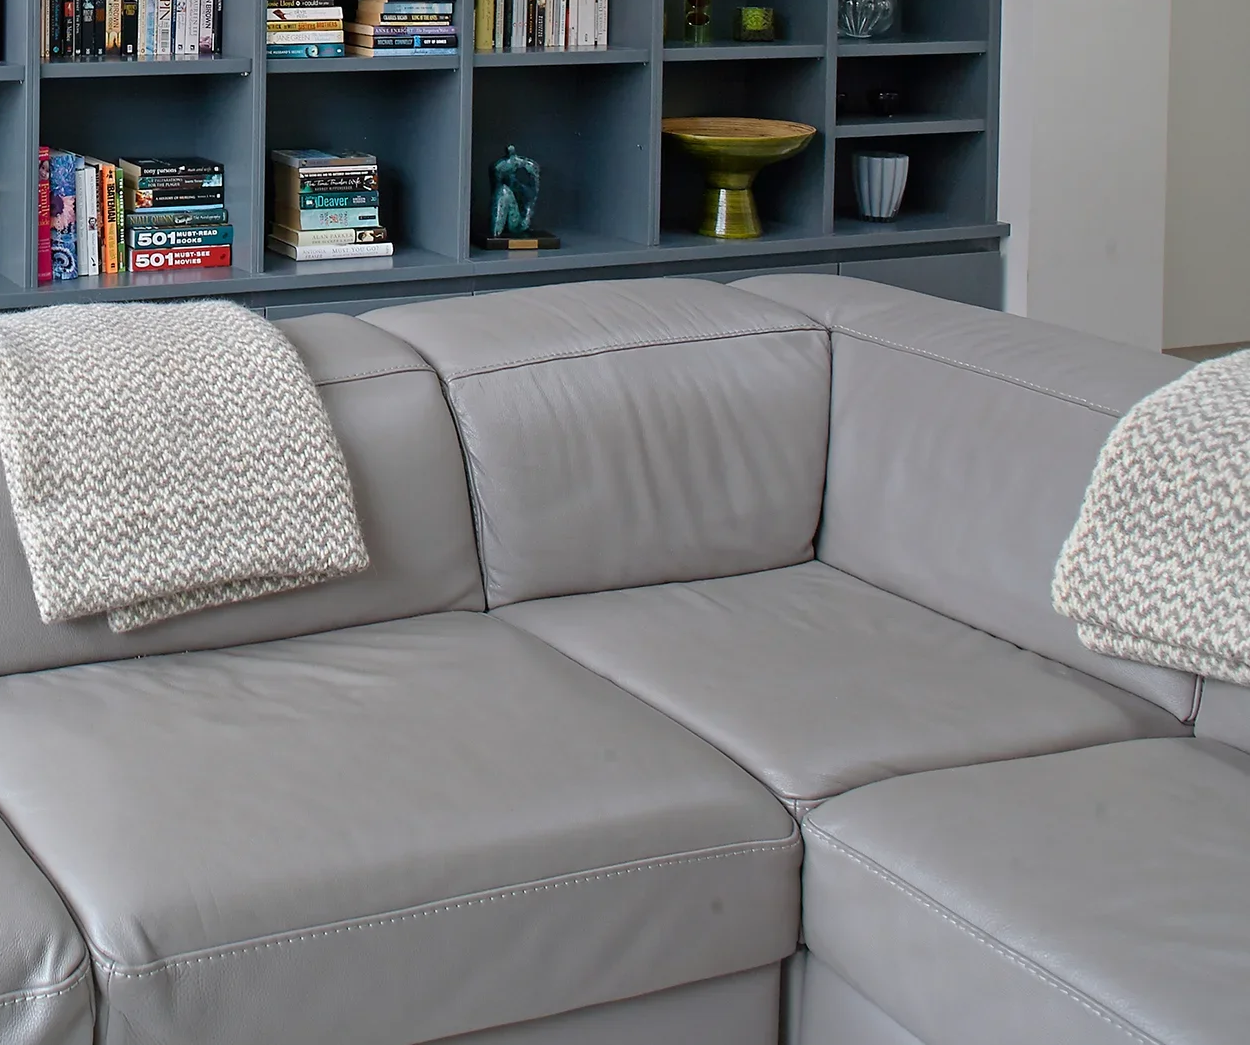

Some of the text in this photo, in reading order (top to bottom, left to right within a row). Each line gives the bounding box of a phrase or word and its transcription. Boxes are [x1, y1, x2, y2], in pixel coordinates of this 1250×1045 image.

[40, 183, 50, 218] Family
[107, 187, 116, 223] BATEMAN
[317, 195, 349, 207] Deaver
[137, 232, 176, 246] 501
[135, 252, 174, 267] 501
